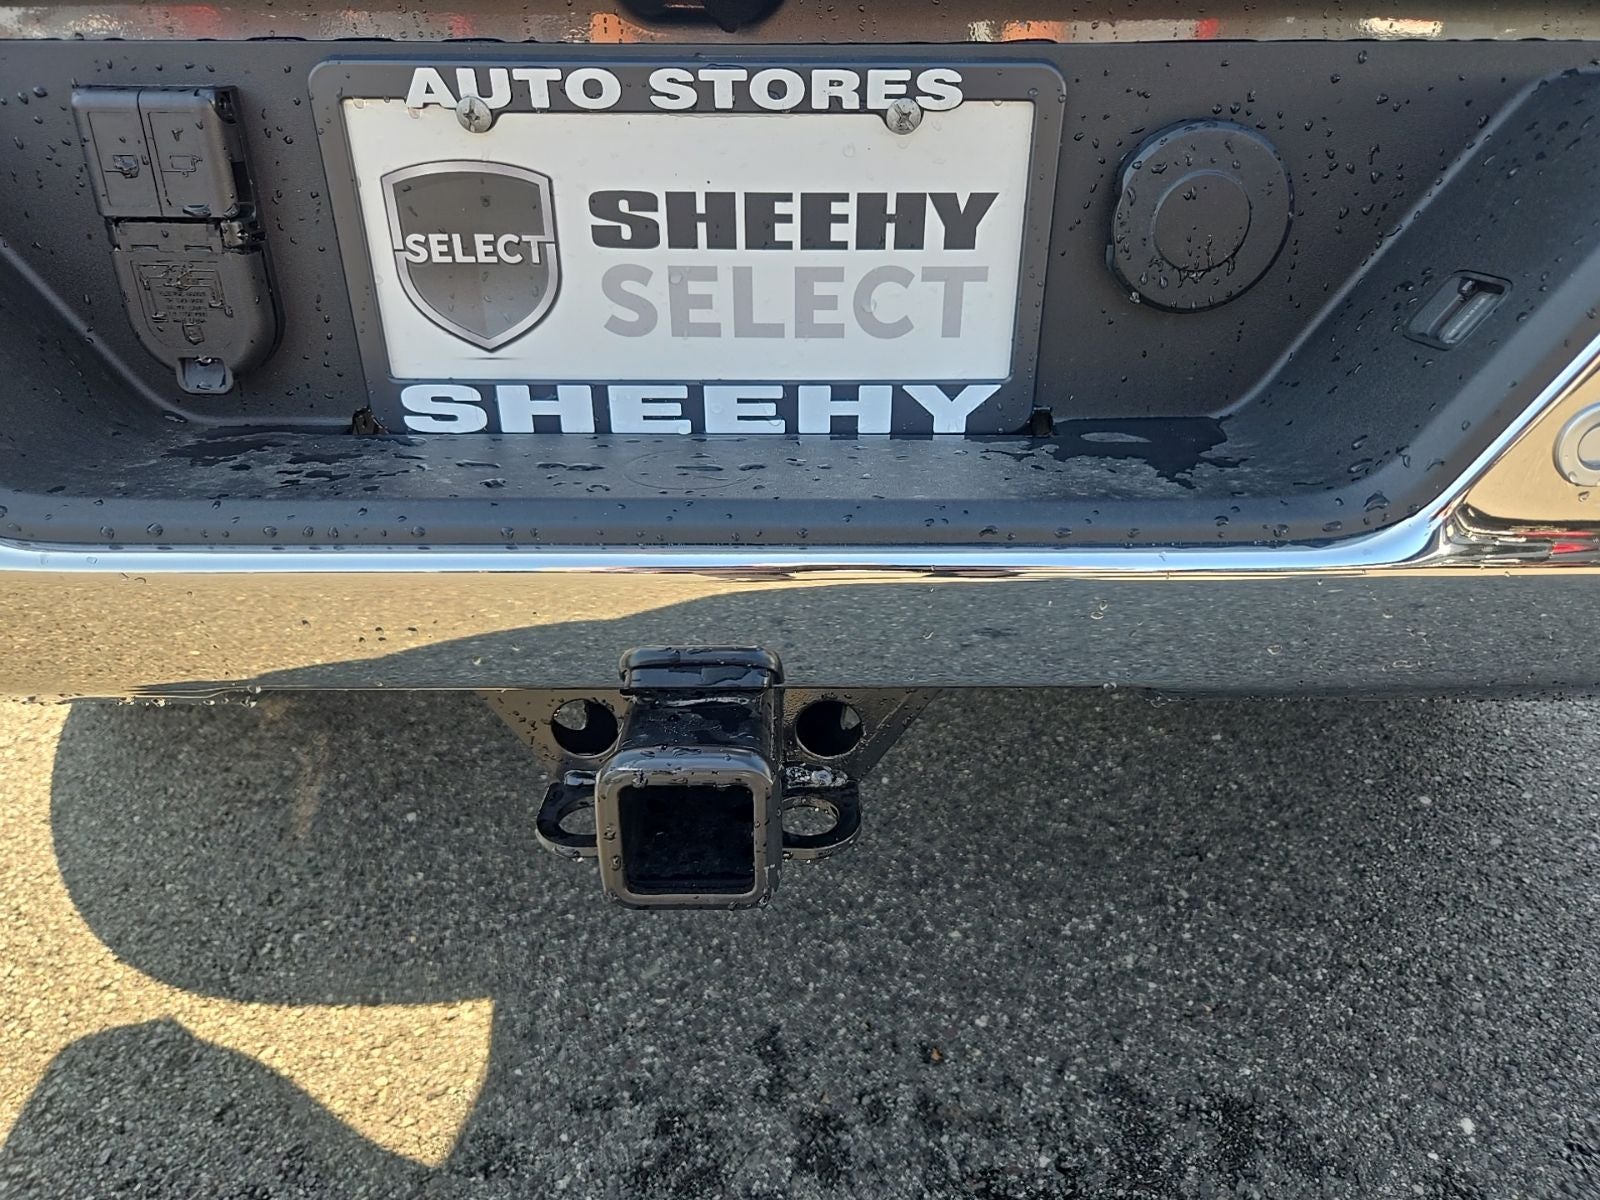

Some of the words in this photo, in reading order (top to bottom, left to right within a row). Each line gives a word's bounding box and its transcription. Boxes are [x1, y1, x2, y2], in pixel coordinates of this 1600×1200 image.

[407, 67, 622, 111] AUTO
[649, 67, 964, 112] STORES
[589, 190, 999, 252] SHEEHY
[405, 232, 545, 266] SELECT
[603, 264, 989, 339] SELECT
[401, 384, 1001, 434] SHEEHY
